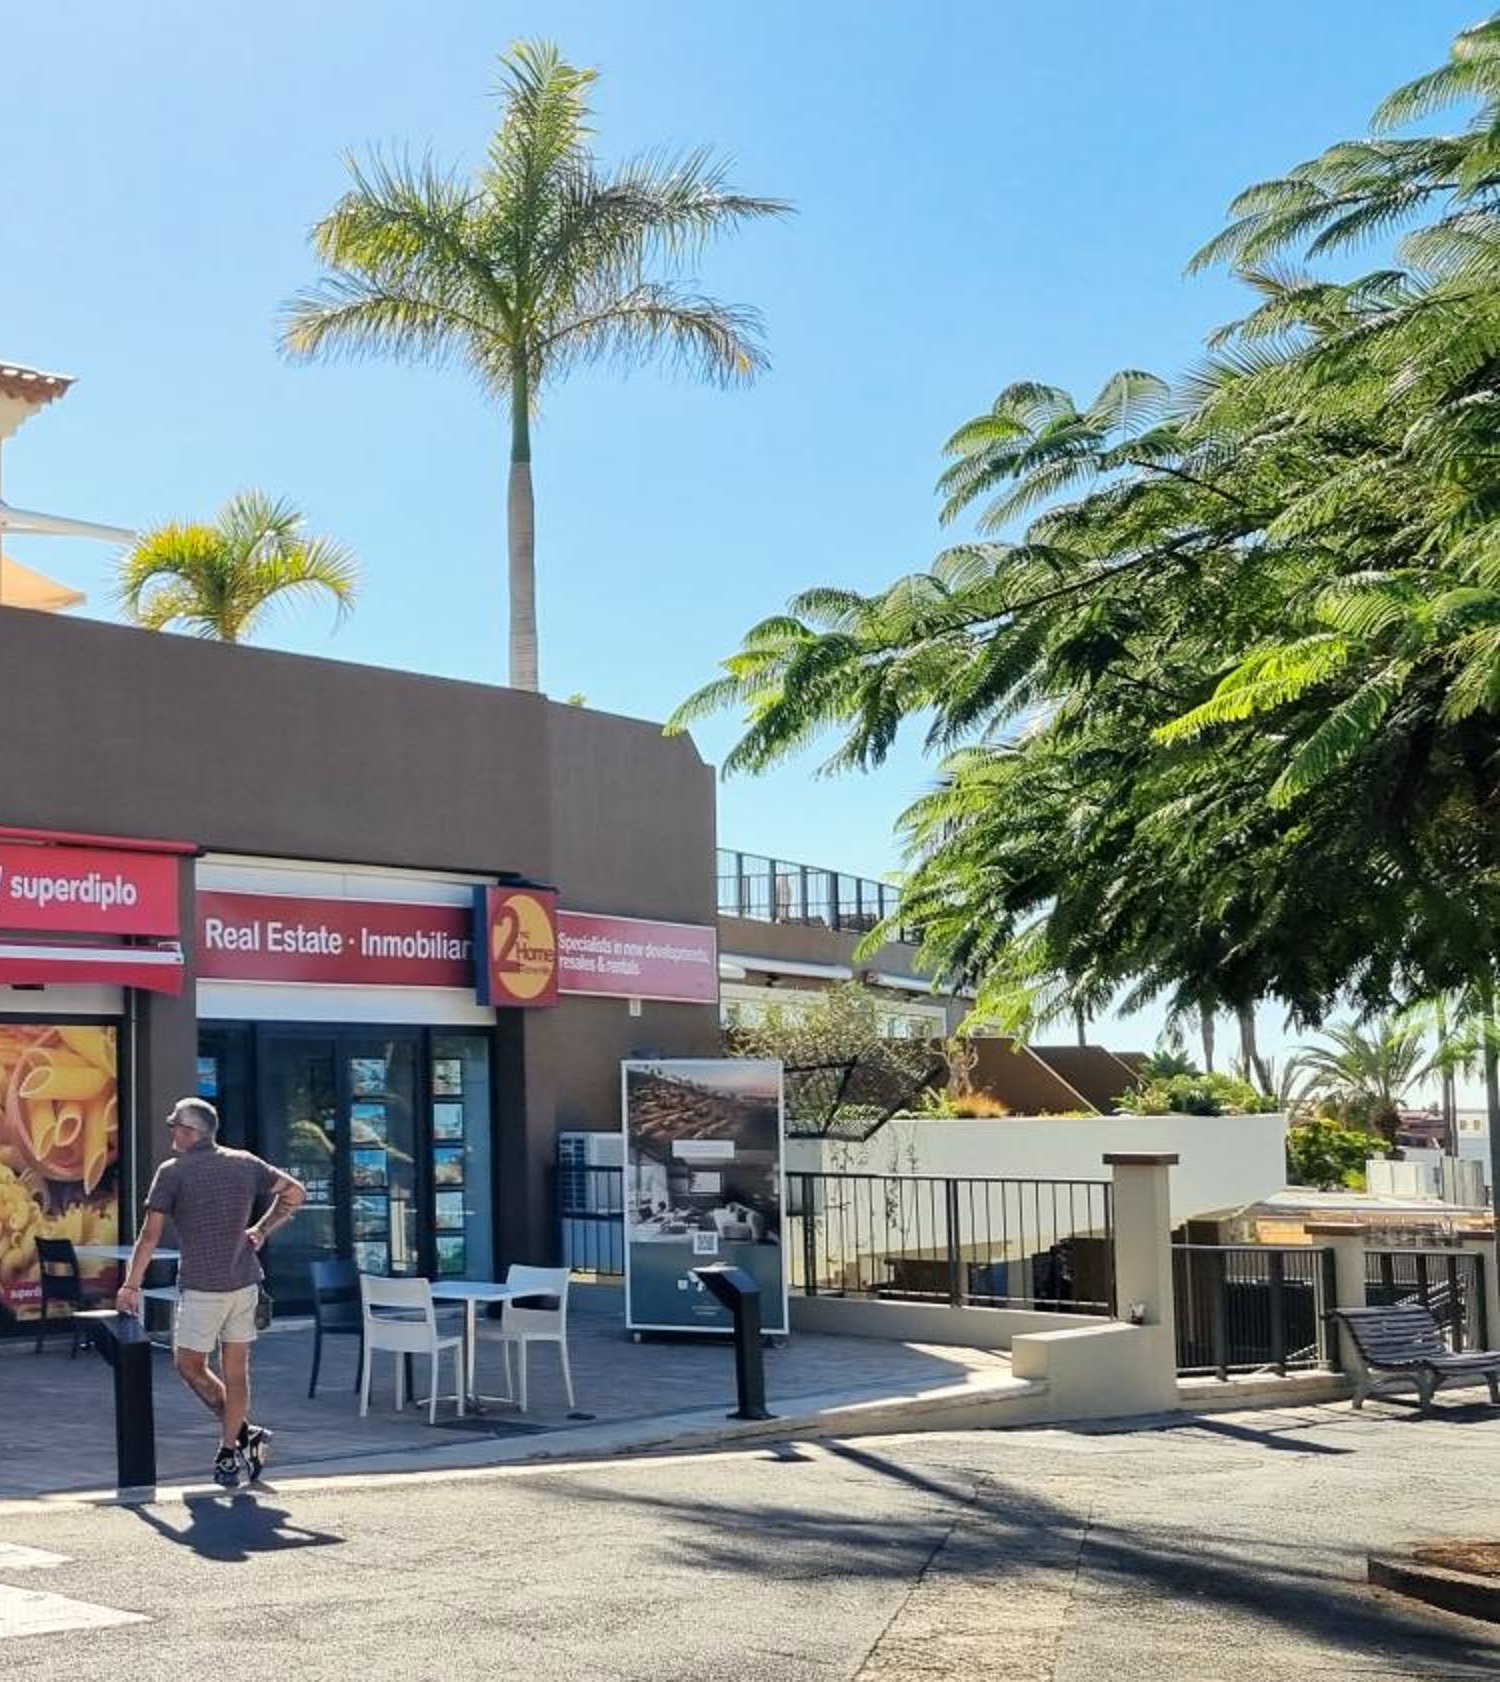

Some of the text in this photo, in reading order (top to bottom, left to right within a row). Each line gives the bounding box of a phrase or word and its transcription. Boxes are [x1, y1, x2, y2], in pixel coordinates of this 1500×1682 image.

[10, 873, 137, 911] superdiplo
[205, 918, 473, 960] Real Estate Inmobiliar
[493, 903, 521, 972] 2
[613, 942, 623, 956] in
